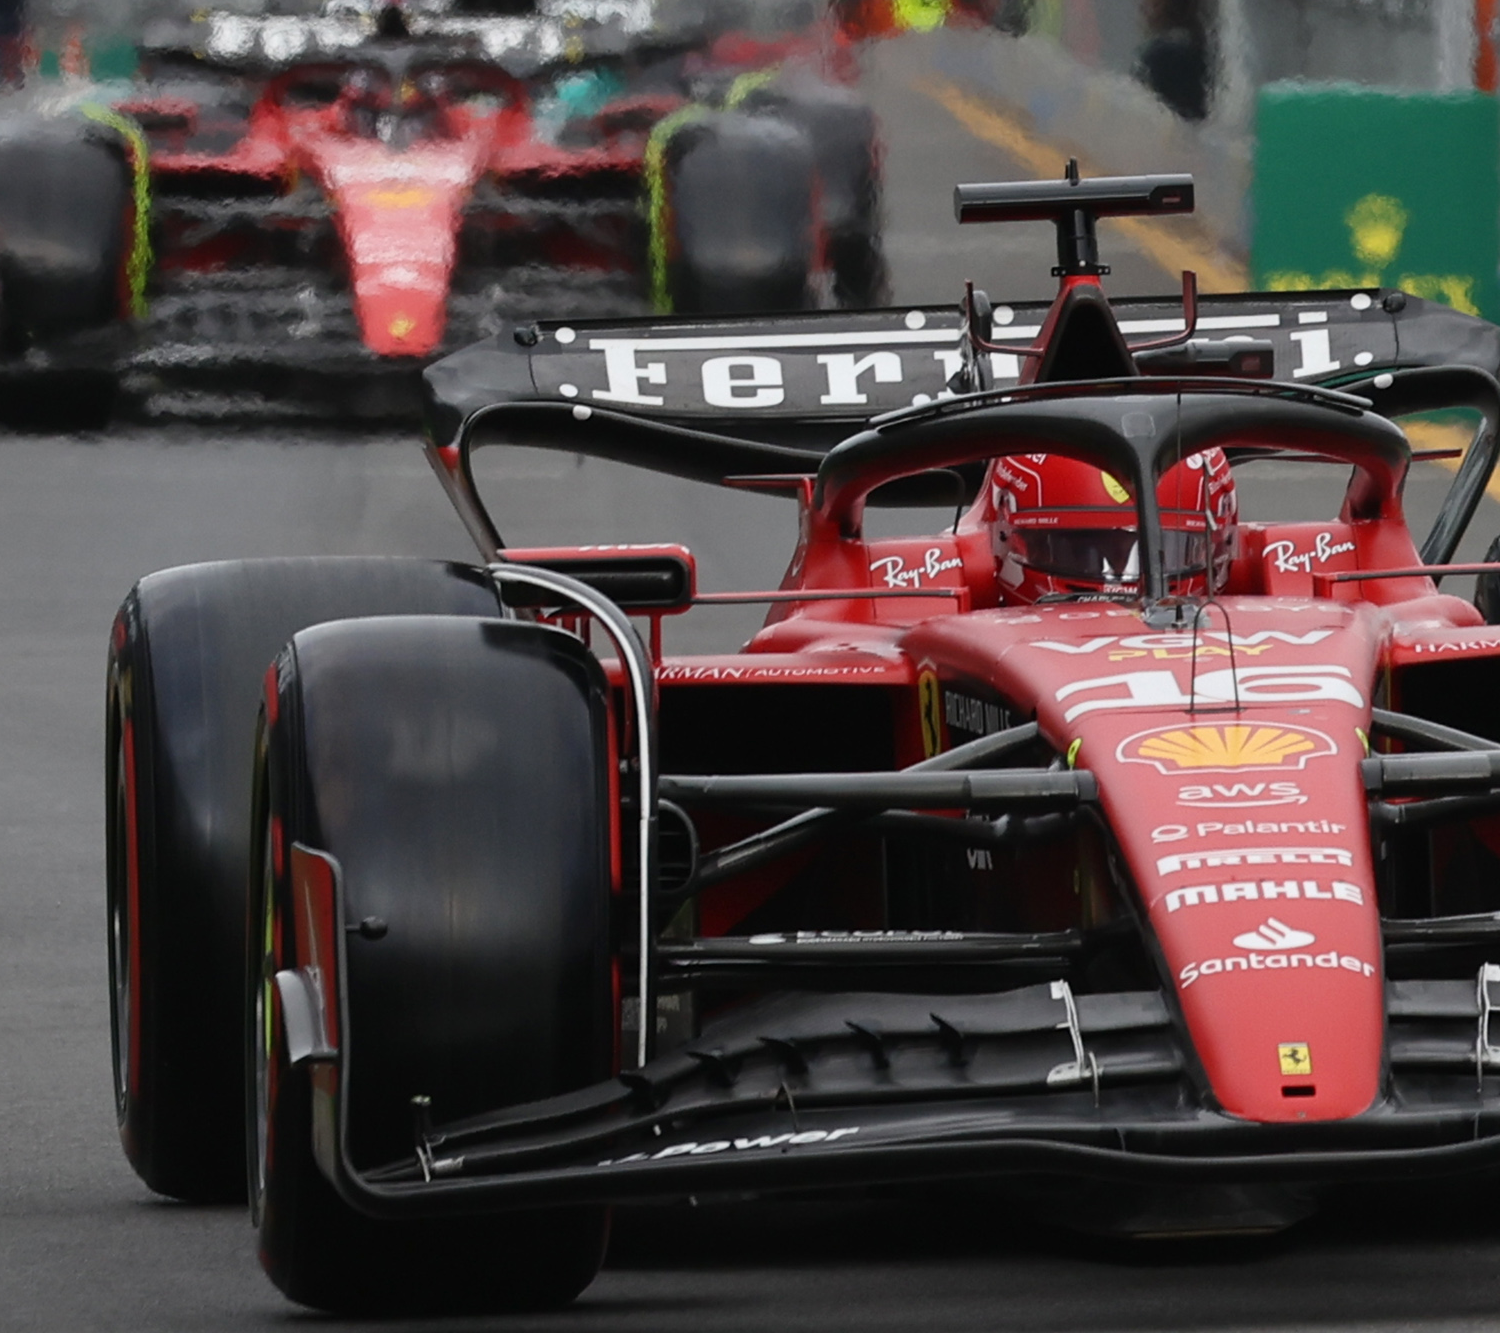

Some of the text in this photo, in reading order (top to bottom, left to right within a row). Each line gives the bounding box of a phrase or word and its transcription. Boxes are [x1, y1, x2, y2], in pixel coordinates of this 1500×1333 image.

[587, 308, 1342, 407] Ferri
[869, 547, 964, 589] Ray-Ban
[1262, 532, 1356, 573] Ray-Ban
[1029, 630, 1335, 654] VGW
[1107, 644, 1275, 661] PLAY
[653, 665, 886, 680] RMAN AUTOMOTIVE
[1056, 665, 1364, 724] 16
[1177, 782, 1302, 801] aws
[1196, 820, 1347, 837] Palantir
[1156, 847, 1353, 876] PIRELLI
[1164, 880, 1364, 913] MAHLE
[1179, 951, 1376, 989] Santander
